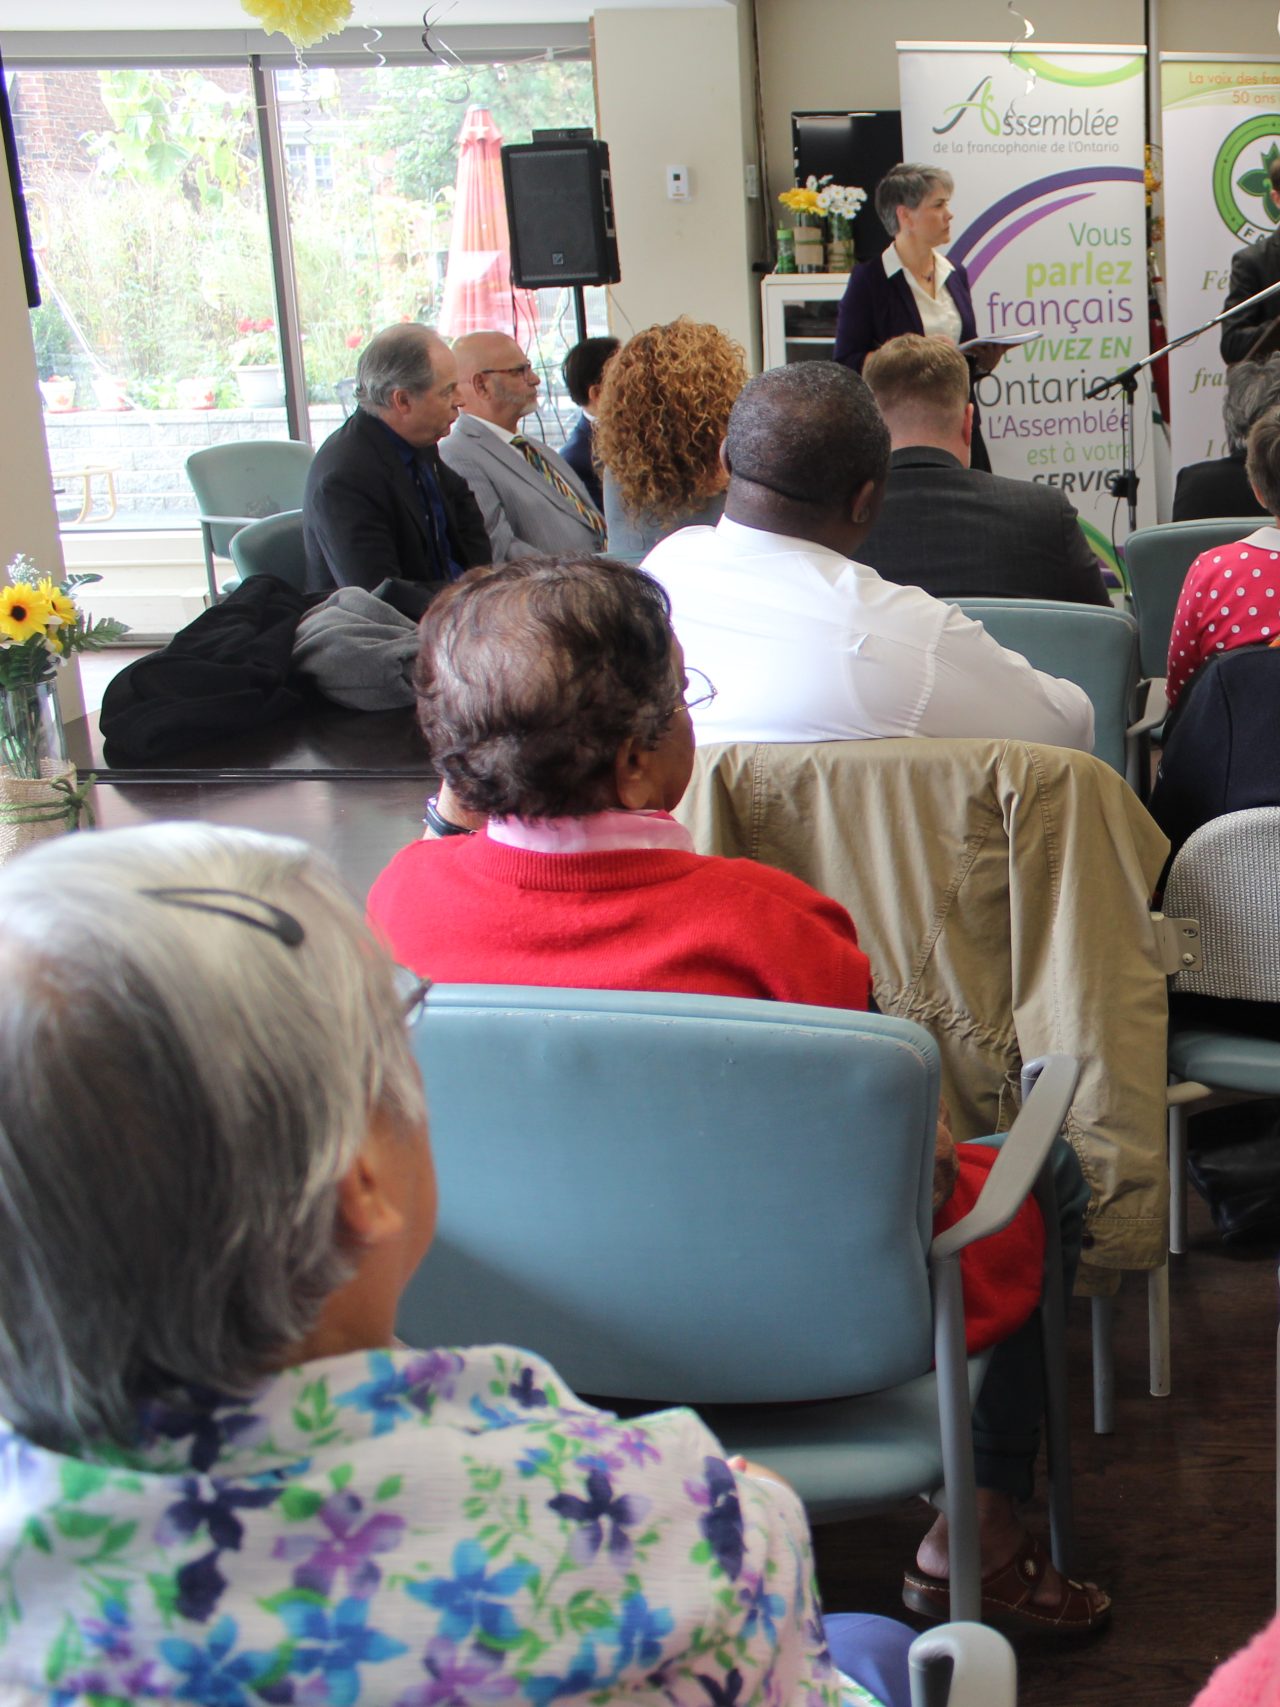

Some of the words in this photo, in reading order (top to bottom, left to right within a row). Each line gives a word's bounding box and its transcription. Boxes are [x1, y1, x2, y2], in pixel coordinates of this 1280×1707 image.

[1189, 72, 1204, 85] La
[1207, 73, 1232, 85] voix
[1236, 73, 1258, 86] des
[932, 75, 1119, 136] Assemblée
[1232, 92, 1249, 105] 50
[1255, 93, 1276, 105] ans
[932, 140, 948, 154] de
[951, 140, 964, 154] la
[967, 140, 1048, 156] francophonie
[1051, 140, 1065, 154] de
[1068, 140, 1120, 154] l'Ontario
[1068, 222, 1132, 247] Vous
[1025, 251, 1133, 298] parlez
[987, 289, 1133, 334] français
[1023, 337, 1093, 363] VIVEZ
[1099, 335, 1133, 359] EN
[1026, 443, 1057, 466] est
[1063, 441, 1075, 463] à
